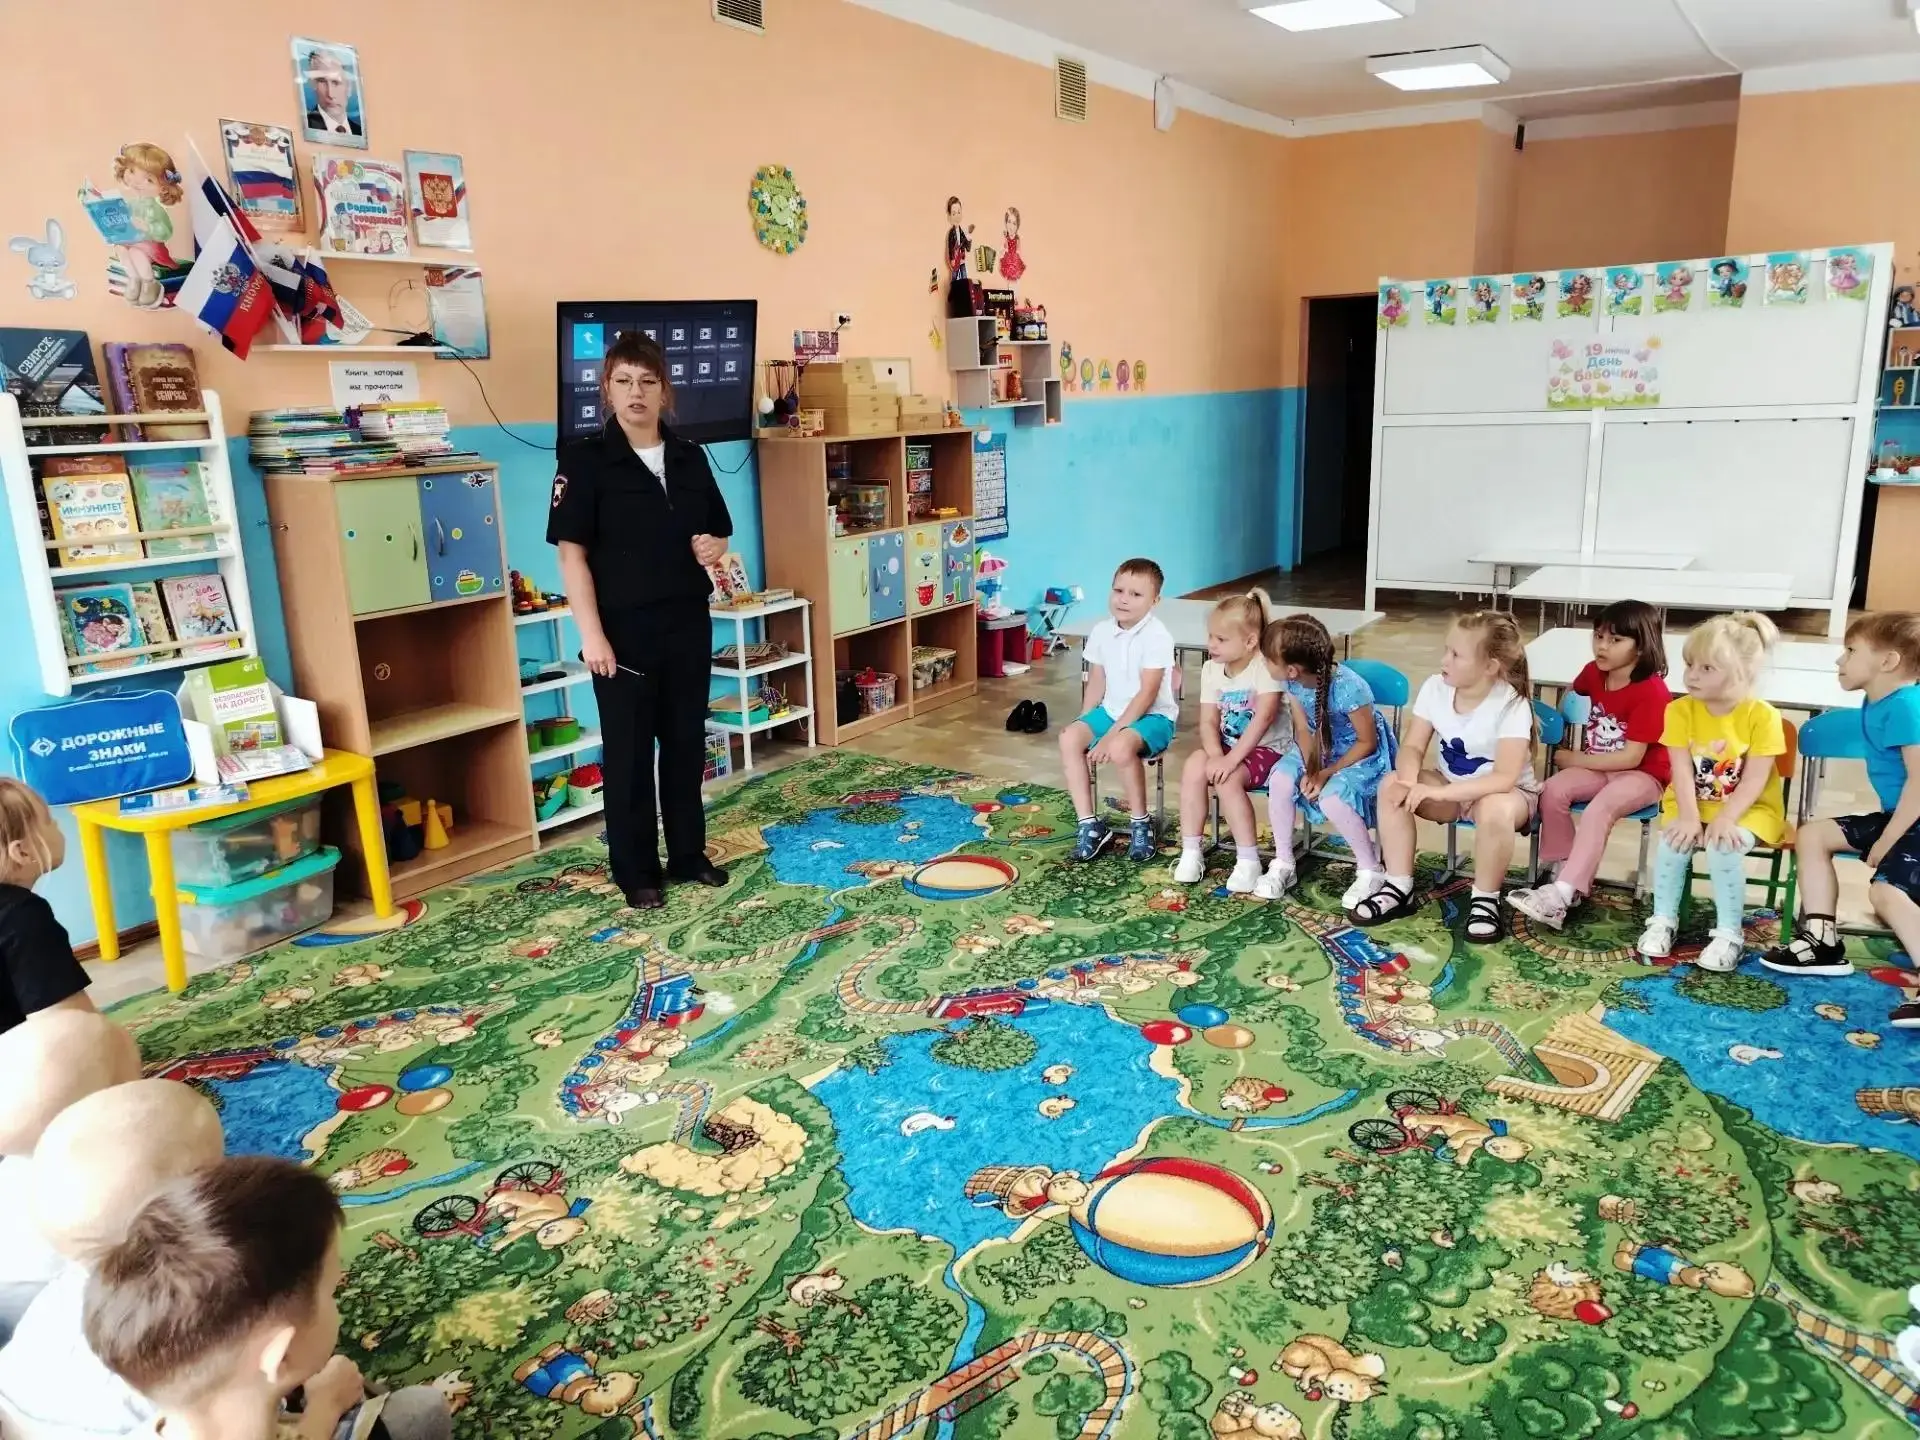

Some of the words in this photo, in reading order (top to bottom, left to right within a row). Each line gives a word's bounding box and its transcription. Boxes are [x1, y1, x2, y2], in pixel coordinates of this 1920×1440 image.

[18, 336, 55, 375] СВИРСК:
[1585, 343, 1602, 357] 19
[1587, 356, 1622, 369] День
[345, 368, 368, 376] Книги
[374, 369, 404, 378] которые
[62, 502, 122, 516] ИММУНИТЕТ
[213, 687, 265, 703] БЕЗОПАСНОСТЬ
[216, 702, 229, 710] НА
[230, 694, 265, 708] ДОРОГЕ
[60, 722, 165, 751] ДОРОЖНЫЕ
[88, 741, 146, 761] ЗНАКИ
